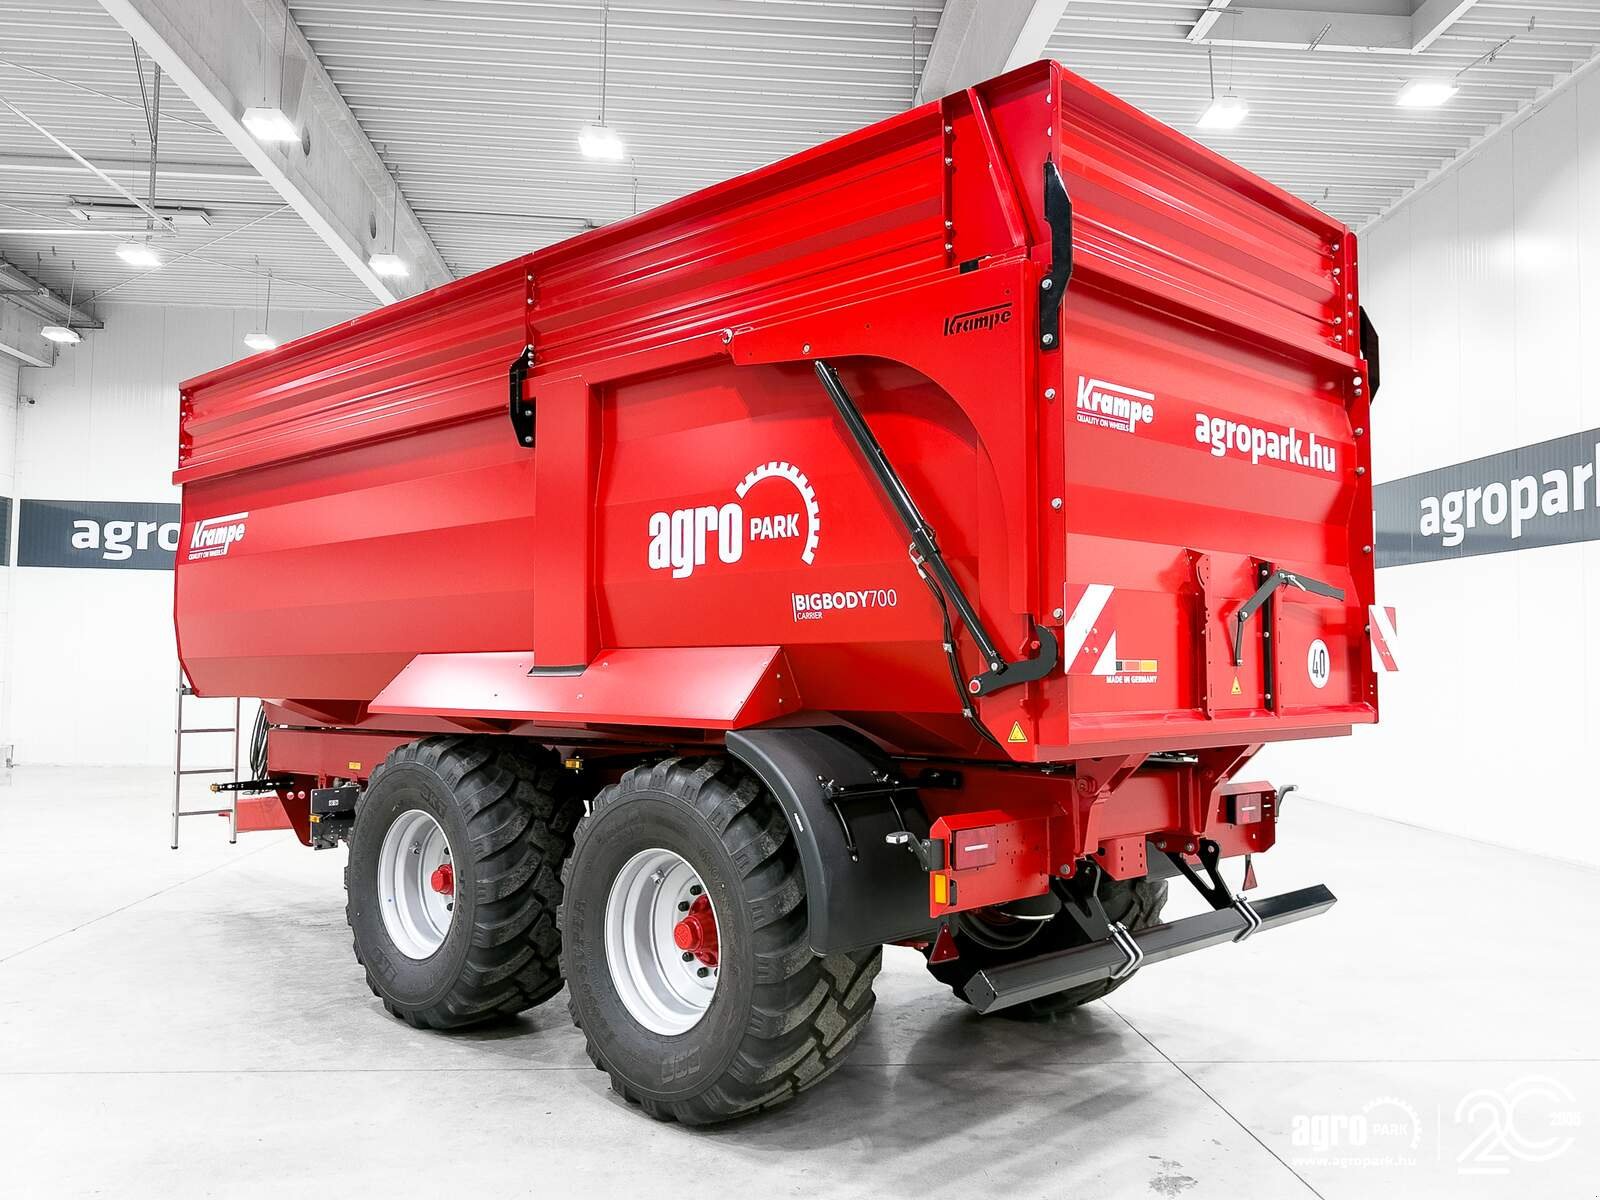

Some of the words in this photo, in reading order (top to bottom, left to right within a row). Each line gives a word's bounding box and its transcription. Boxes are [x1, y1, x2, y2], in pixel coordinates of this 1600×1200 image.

[943, 302, 1013, 336] Krampe
[1076, 375, 1155, 433] Krampe
[1076, 414, 1100, 425] QUALITY
[1100, 419, 1109, 428] ON
[1109, 422, 1129, 432] WHEELS
[1195, 412, 1336, 473] agropark.hu
[1420, 442, 1600, 547] agropar
[71, 519, 181, 561] agro
[190, 511, 249, 556] Krampe
[648, 502, 743, 579] agro
[750, 513, 800, 541] PARK
[795, 589, 897, 611] BIGBODY700
[796, 611, 823, 620] CARRIER
[1106, 675, 1123, 684] MADE
[1123, 675, 1131, 684] IN
[1130, 675, 1157, 684] GERMANY
[1312, 649, 1326, 678] 40
